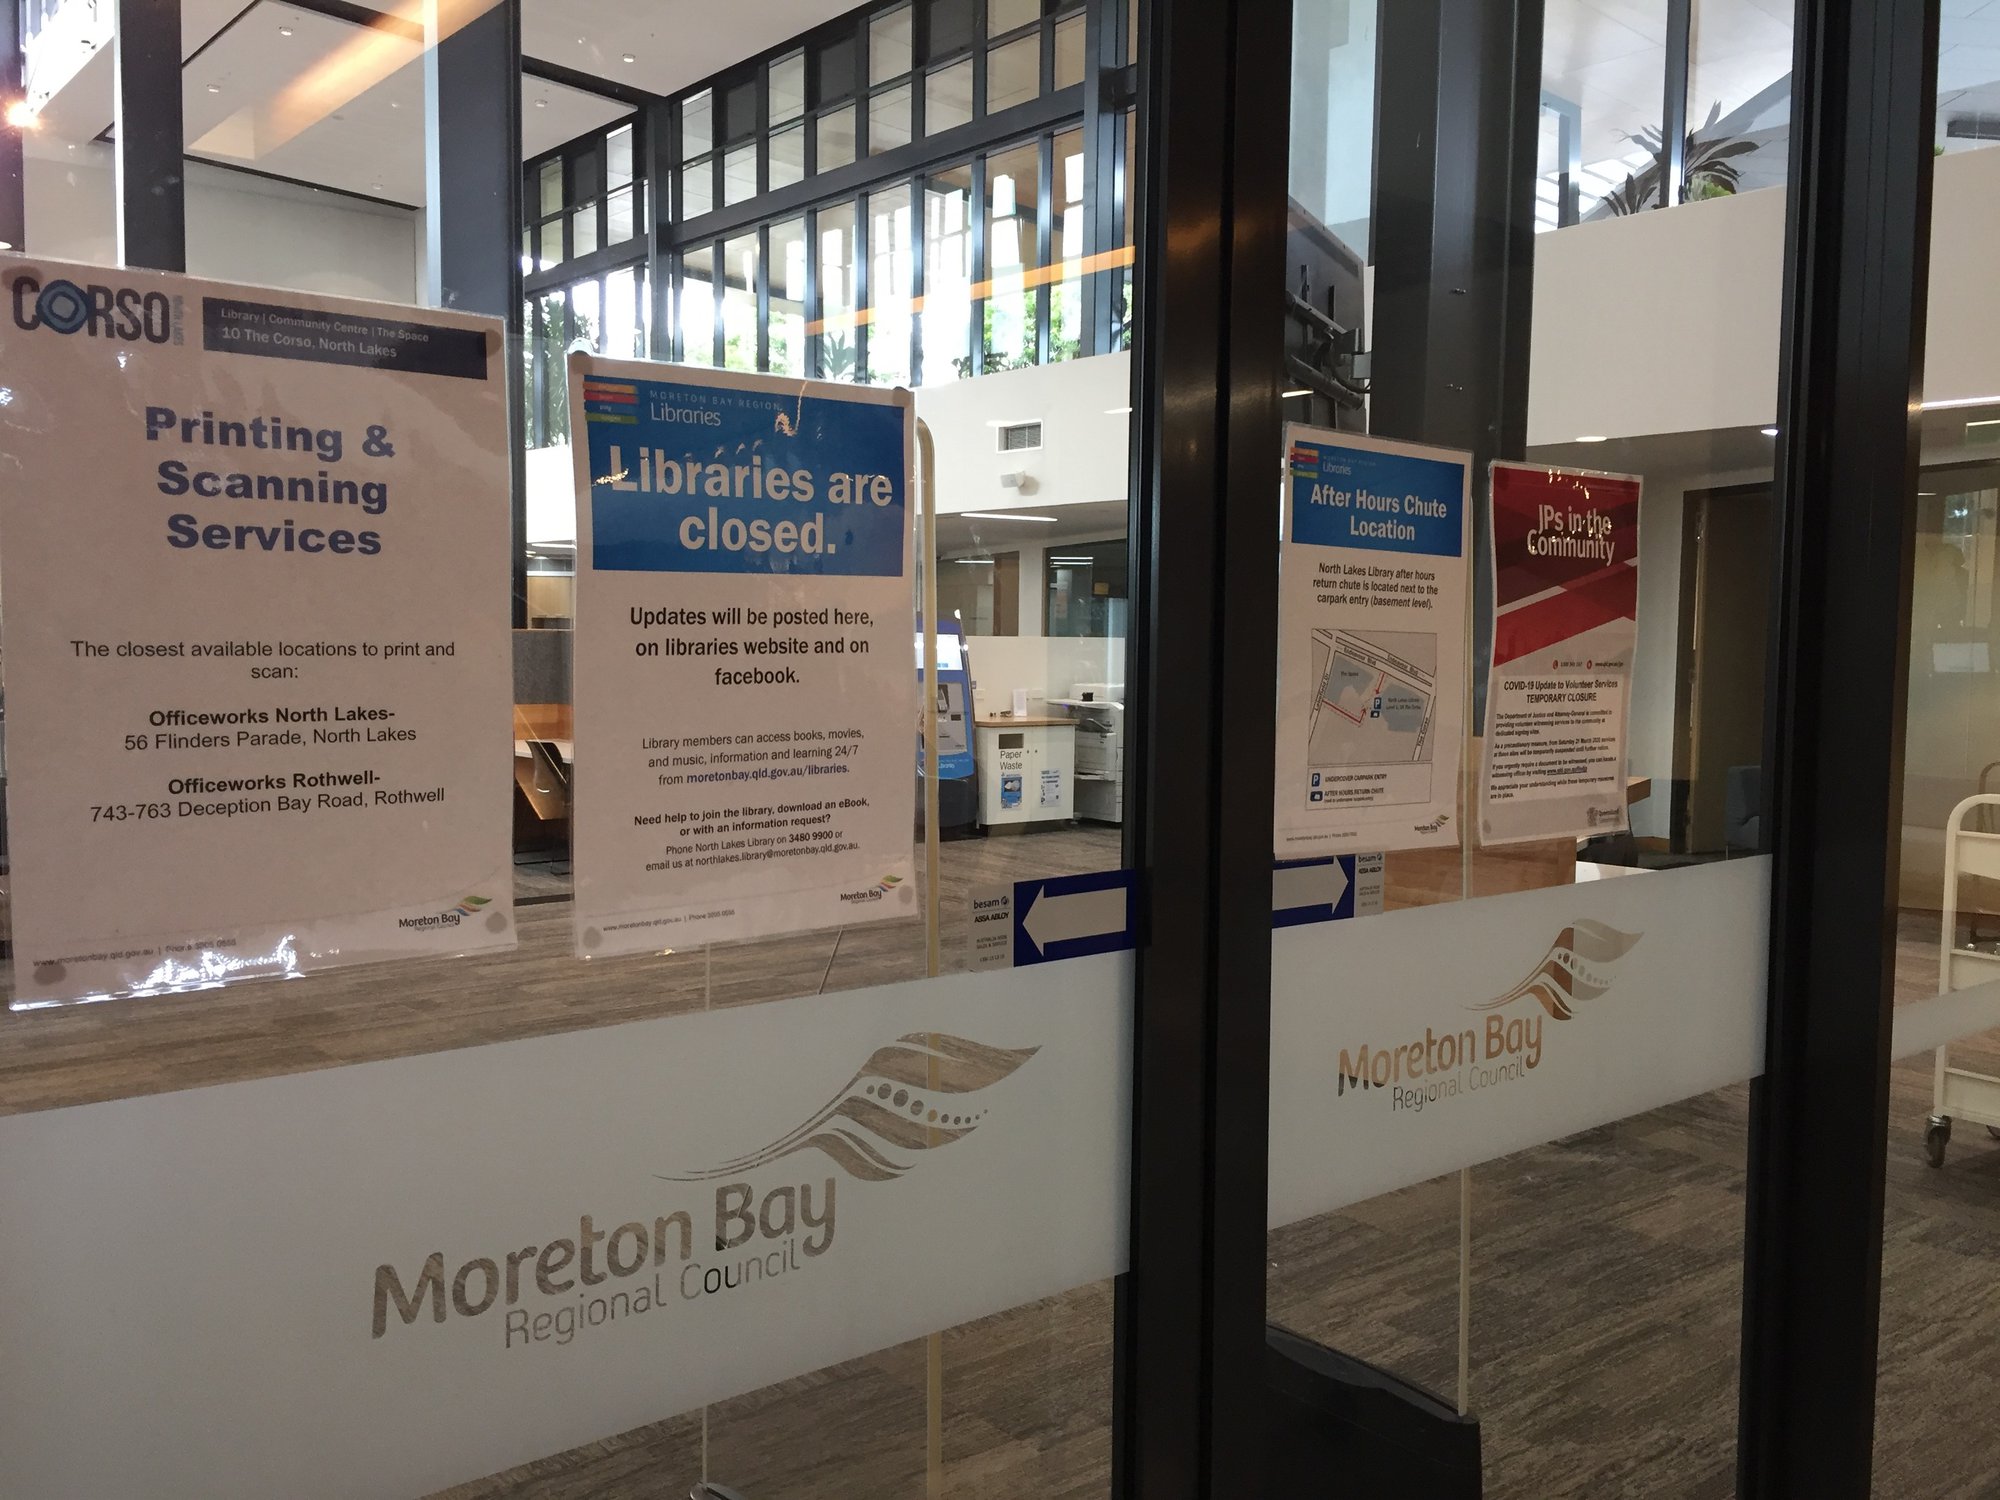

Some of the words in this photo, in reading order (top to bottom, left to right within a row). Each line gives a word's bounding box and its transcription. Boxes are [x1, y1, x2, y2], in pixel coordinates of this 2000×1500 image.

[12, 276, 170, 344] CORSO
[221, 308, 259, 323] Library
[269, 314, 331, 332] Community
[334, 322, 368, 335] Centre
[377, 327, 395, 338] The
[398, 329, 429, 342] Space
[222, 327, 240, 339] 10
[245, 329, 268, 343] The
[273, 332, 316, 348] Corso,
[319, 337, 356, 353] North
[359, 343, 397, 358] Lakes
[650, 390, 707, 404] MORETON
[712, 397, 733, 405] BAY
[651, 403, 721, 426] Libraries
[145, 406, 342, 463] Printing
[361, 425, 396, 458] &
[610, 445, 814, 502] Libraries
[828, 471, 893, 506] are
[157, 461, 387, 514] Scanning
[1311, 484, 1351, 507] After
[1356, 489, 1399, 513] Hours
[1404, 495, 1447, 518] Chute
[679, 506, 836, 554] closed.
[1350, 516, 1415, 540] Location
[1538, 504, 1564, 533] JPs
[1568, 506, 1582, 532] in
[1586, 508, 1611, 535] the
[167, 513, 382, 555] Services
[1527, 529, 1615, 566] Community
[1319, 563, 1341, 573] North
[1344, 565, 1366, 576] Lakes
[1368, 566, 1394, 579] Library
[1396, 569, 1413, 579] after
[1415, 570, 1435, 580] hours
[1313, 579, 1337, 588] return
[1339, 580, 1360, 589] chute
[1363, 580, 1369, 590] is
[1371, 581, 1398, 592] located
[1401, 585, 1418, 593] next
[1418, 585, 1425, 594] to
[1427, 585, 1438, 595] the
[1317, 594, 1347, 605] carpark
[1349, 596, 1369, 607] entry
[1371, 595, 1410, 607] (basement
[1412, 598, 1433, 610] level).
[630, 607, 706, 629] Updates
[712, 608, 741, 624] will
[747, 608, 767, 624] be
[773, 608, 828, 628] posted
[834, 609, 874, 627] here,
[70, 641, 109, 656] The
[116, 641, 184, 657] closest
[191, 641, 272, 657] available
[279, 642, 357, 656] locations
[362, 643, 378, 656] to
[384, 642, 420, 659] print
[425, 642, 455, 656] and
[636, 642, 658, 656] on
[666, 638, 738, 655] libraries
[744, 637, 808, 654] website
[814, 637, 844, 653] and
[850, 640, 869, 653] on
[251, 666, 298, 678] scan:
[715, 667, 800, 685] facebook.
[1504, 681, 1534, 690] COVID-19
[1535, 681, 1556, 691] Update
[1565, 681, 1593, 689] Volunteer
[1595, 680, 1618, 688] Services
[1527, 694, 1566, 703] TEMPORARY
[1568, 693, 1597, 701] CLOSURE
[149, 709, 269, 726] Officeworks
[276, 707, 328, 723] North
[335, 706, 395, 721] Lakes-
[125, 735, 148, 750] 56
[155, 733, 230, 749] Flinders
[237, 730, 306, 746] Parade,
[313, 728, 360, 744] North
[367, 727, 416, 742] Lakes
[642, 737, 679, 750] Library
[683, 736, 732, 747] members
[735, 735, 753, 744] can
[757, 733, 790, 743] access
[793, 731, 825, 741] books,
[828, 728, 864, 739] movies,
[648, 757, 669, 767] and
[672, 754, 707, 766] music,
[710, 750, 768, 763] information
[771, 750, 790, 760] and
[793, 747, 832, 758] learning
[835, 745, 858, 756] 24/7
[1000, 751, 1021, 759] Paper
[1000, 762, 1022, 770] Waste
[168, 775, 286, 794] Officeworks
[293, 770, 380, 788] Rothwell-
[658, 774, 683, 785] from
[687, 765, 849, 784] moretonbay.qld.gov.au/libraries.
[91, 803, 171, 822] 743-763
[179, 798, 271, 817] Deception
[278, 796, 311, 813] Bay
[318, 792, 367, 808] Road,
[375, 788, 444, 805] Rothwell
[634, 815, 661, 825] Need
[665, 812, 687, 824] help
[690, 811, 700, 821] to
[702, 810, 720, 822] join
[723, 808, 739, 818] the
[742, 806, 775, 817] library,
[777, 803, 822, 814] download
[825, 801, 836, 809] an
[839, 798, 870, 808] eBook,
[680, 828, 690, 836] or
[693, 825, 714, 834] with
[717, 824, 729, 833] an
[732, 819, 788, 831] information
[790, 814, 831, 827] request?
[666, 845, 693, 855] Phone
[696, 842, 718, 852] North
[721, 840, 745, 850] Lakes
[748, 837, 775, 848] Library
[777, 836, 787, 844] on
[789, 833, 810, 843] 3480
[812, 831, 833, 841] 9900
[835, 830, 843, 839] or
[646, 860, 670, 871] email
[672, 859, 683, 868] us
[685, 857, 694, 867] at
[696, 842, 860, 866] northlakes.library@moretonbay.qld.gov.au.
[974, 899, 999, 909] besam
[399, 916, 439, 928] Moreton
[441, 914, 460, 925] Bay
[975, 915, 990, 923] ASSA
[991, 912, 1009, 920] ABLOY
[1337, 1028, 1476, 1097] Moreton
[1485, 1014, 1543, 1070] Bay
[1393, 1076, 1462, 1113] Regional
[1469, 1056, 1525, 1091] Council
[371, 1211, 693, 1340] Moreton
[713, 1177, 837, 1258] Bay
[504, 1281, 667, 1350] Regional
[680, 1242, 801, 1299] Council
